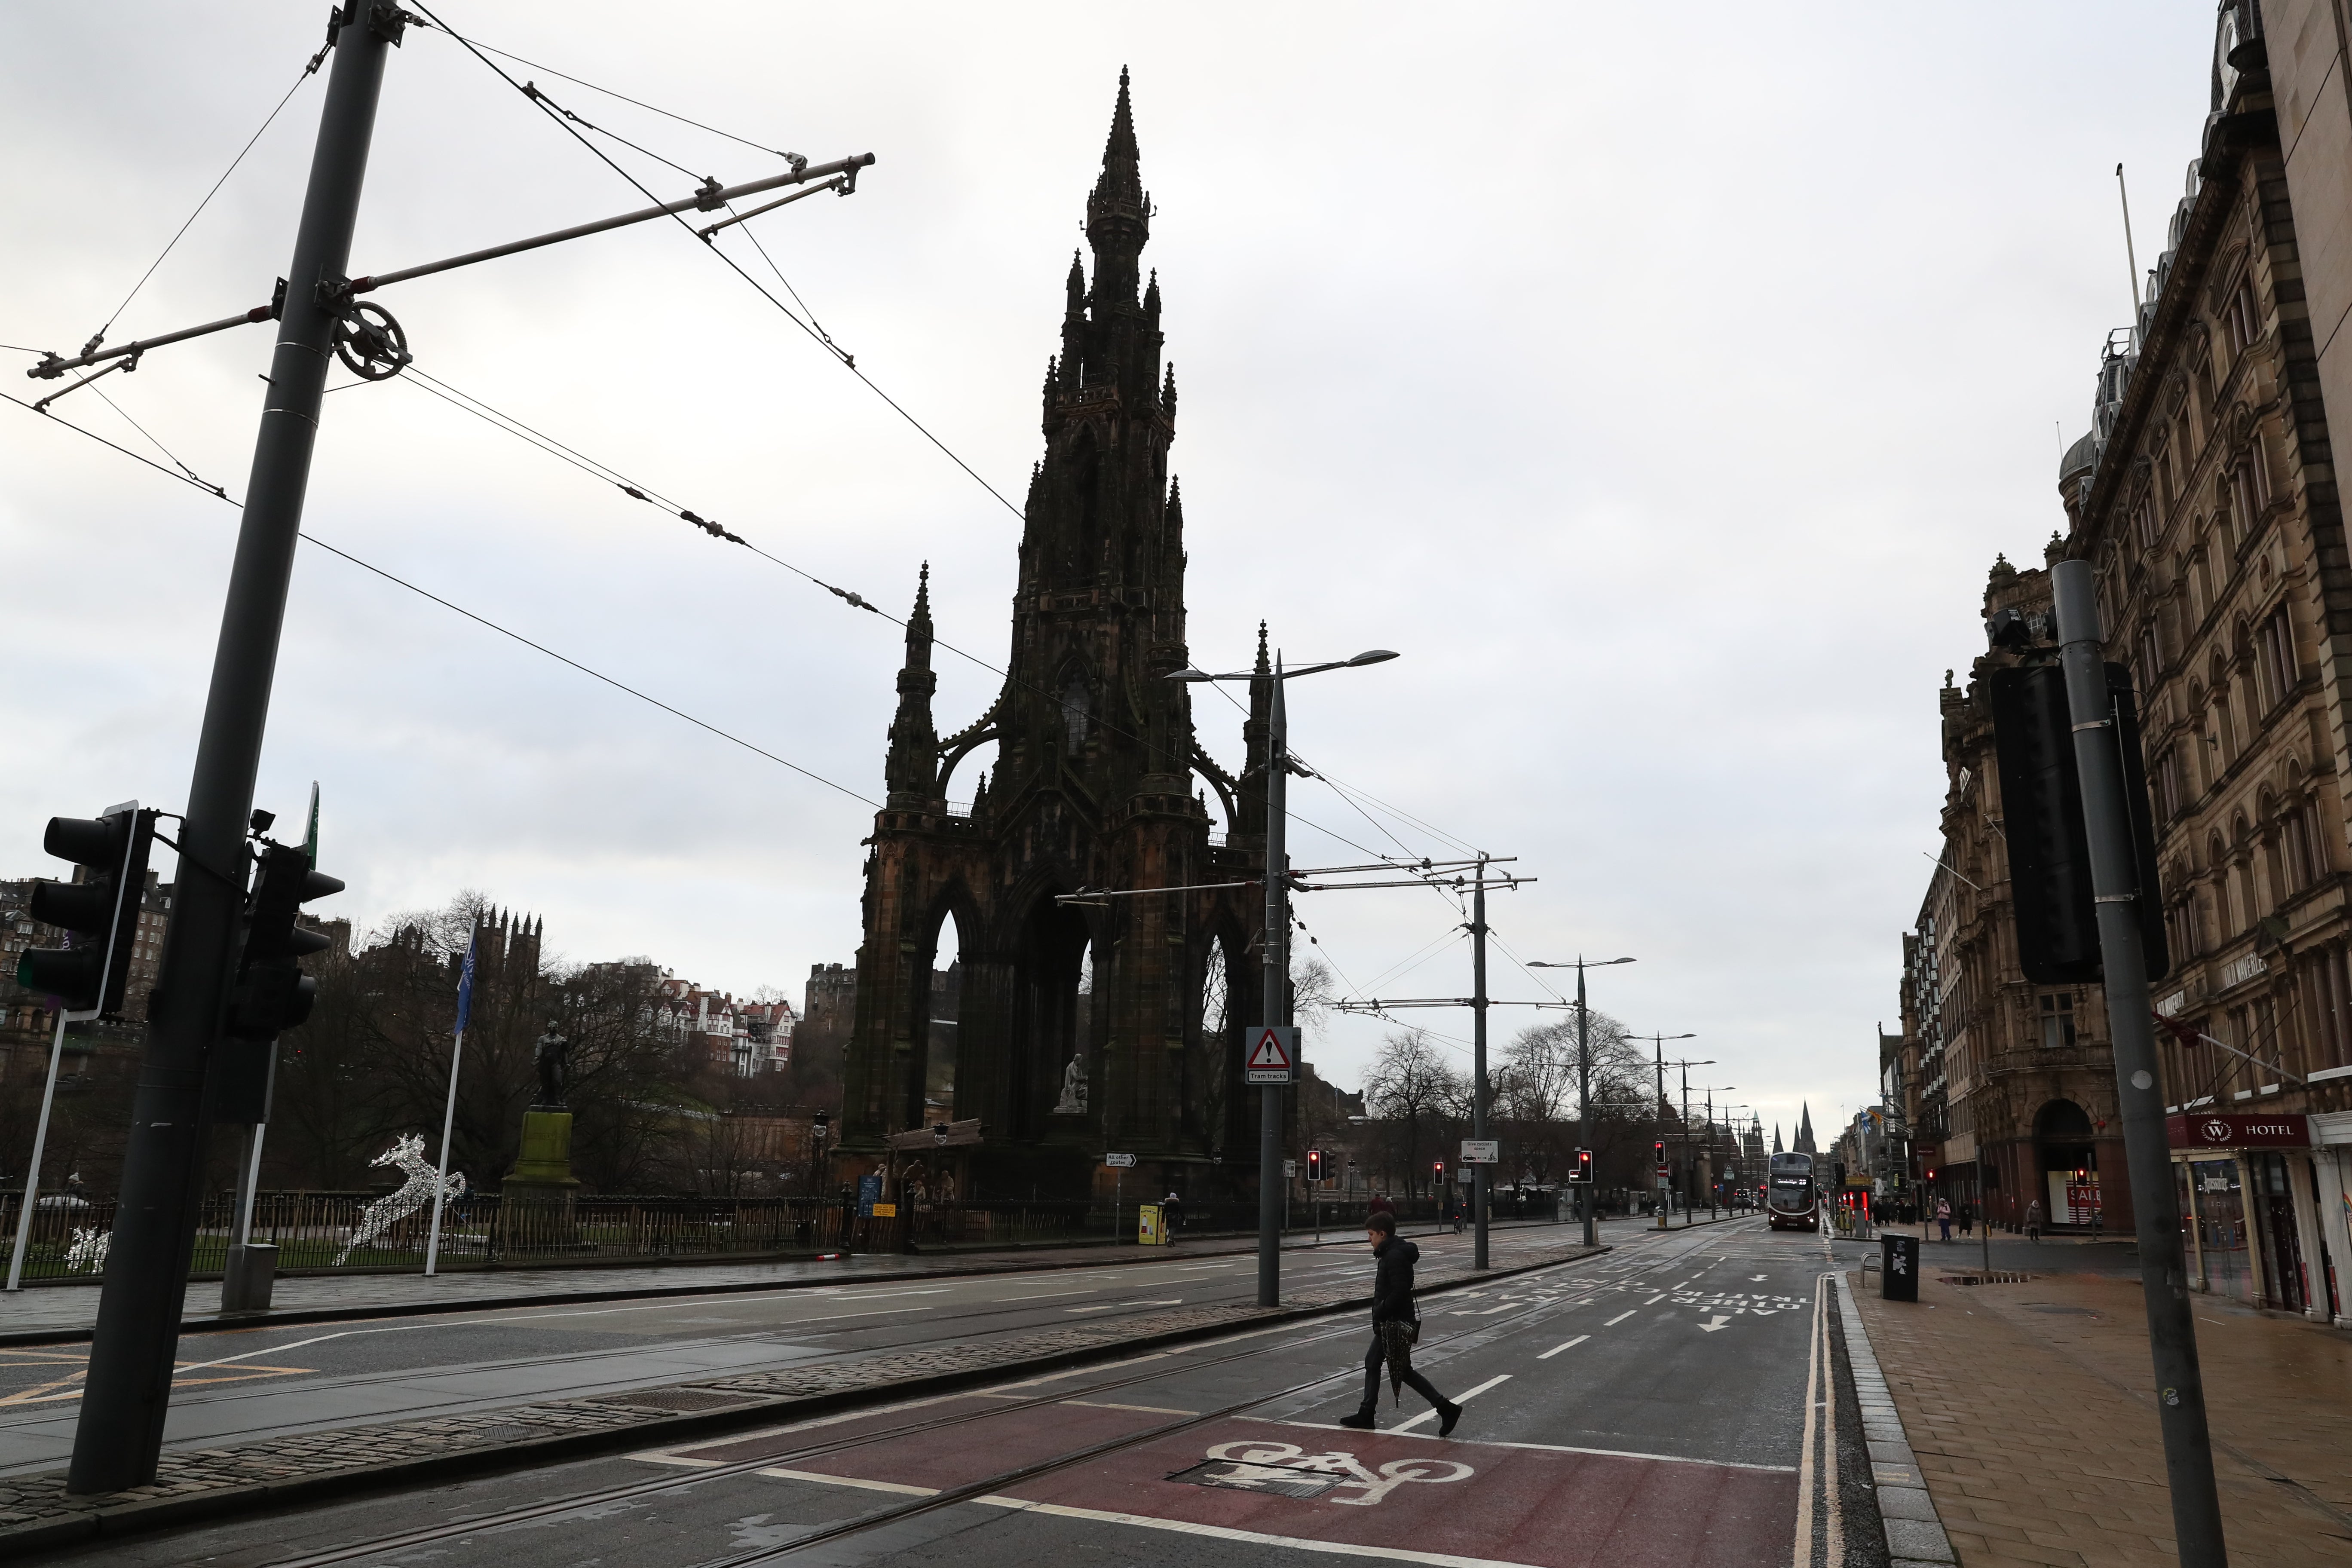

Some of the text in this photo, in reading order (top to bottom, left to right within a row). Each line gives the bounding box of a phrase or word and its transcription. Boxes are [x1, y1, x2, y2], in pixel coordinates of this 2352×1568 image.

[2224, 951, 2267, 987] OLD WAVERLE
[2245, 1125, 2294, 1135] HOTEL
[1670, 1296, 1801, 1310] OTHER
[1672, 1290, 1813, 1303] TRAFFIC
[1684, 1305, 1780, 1316] ALL
